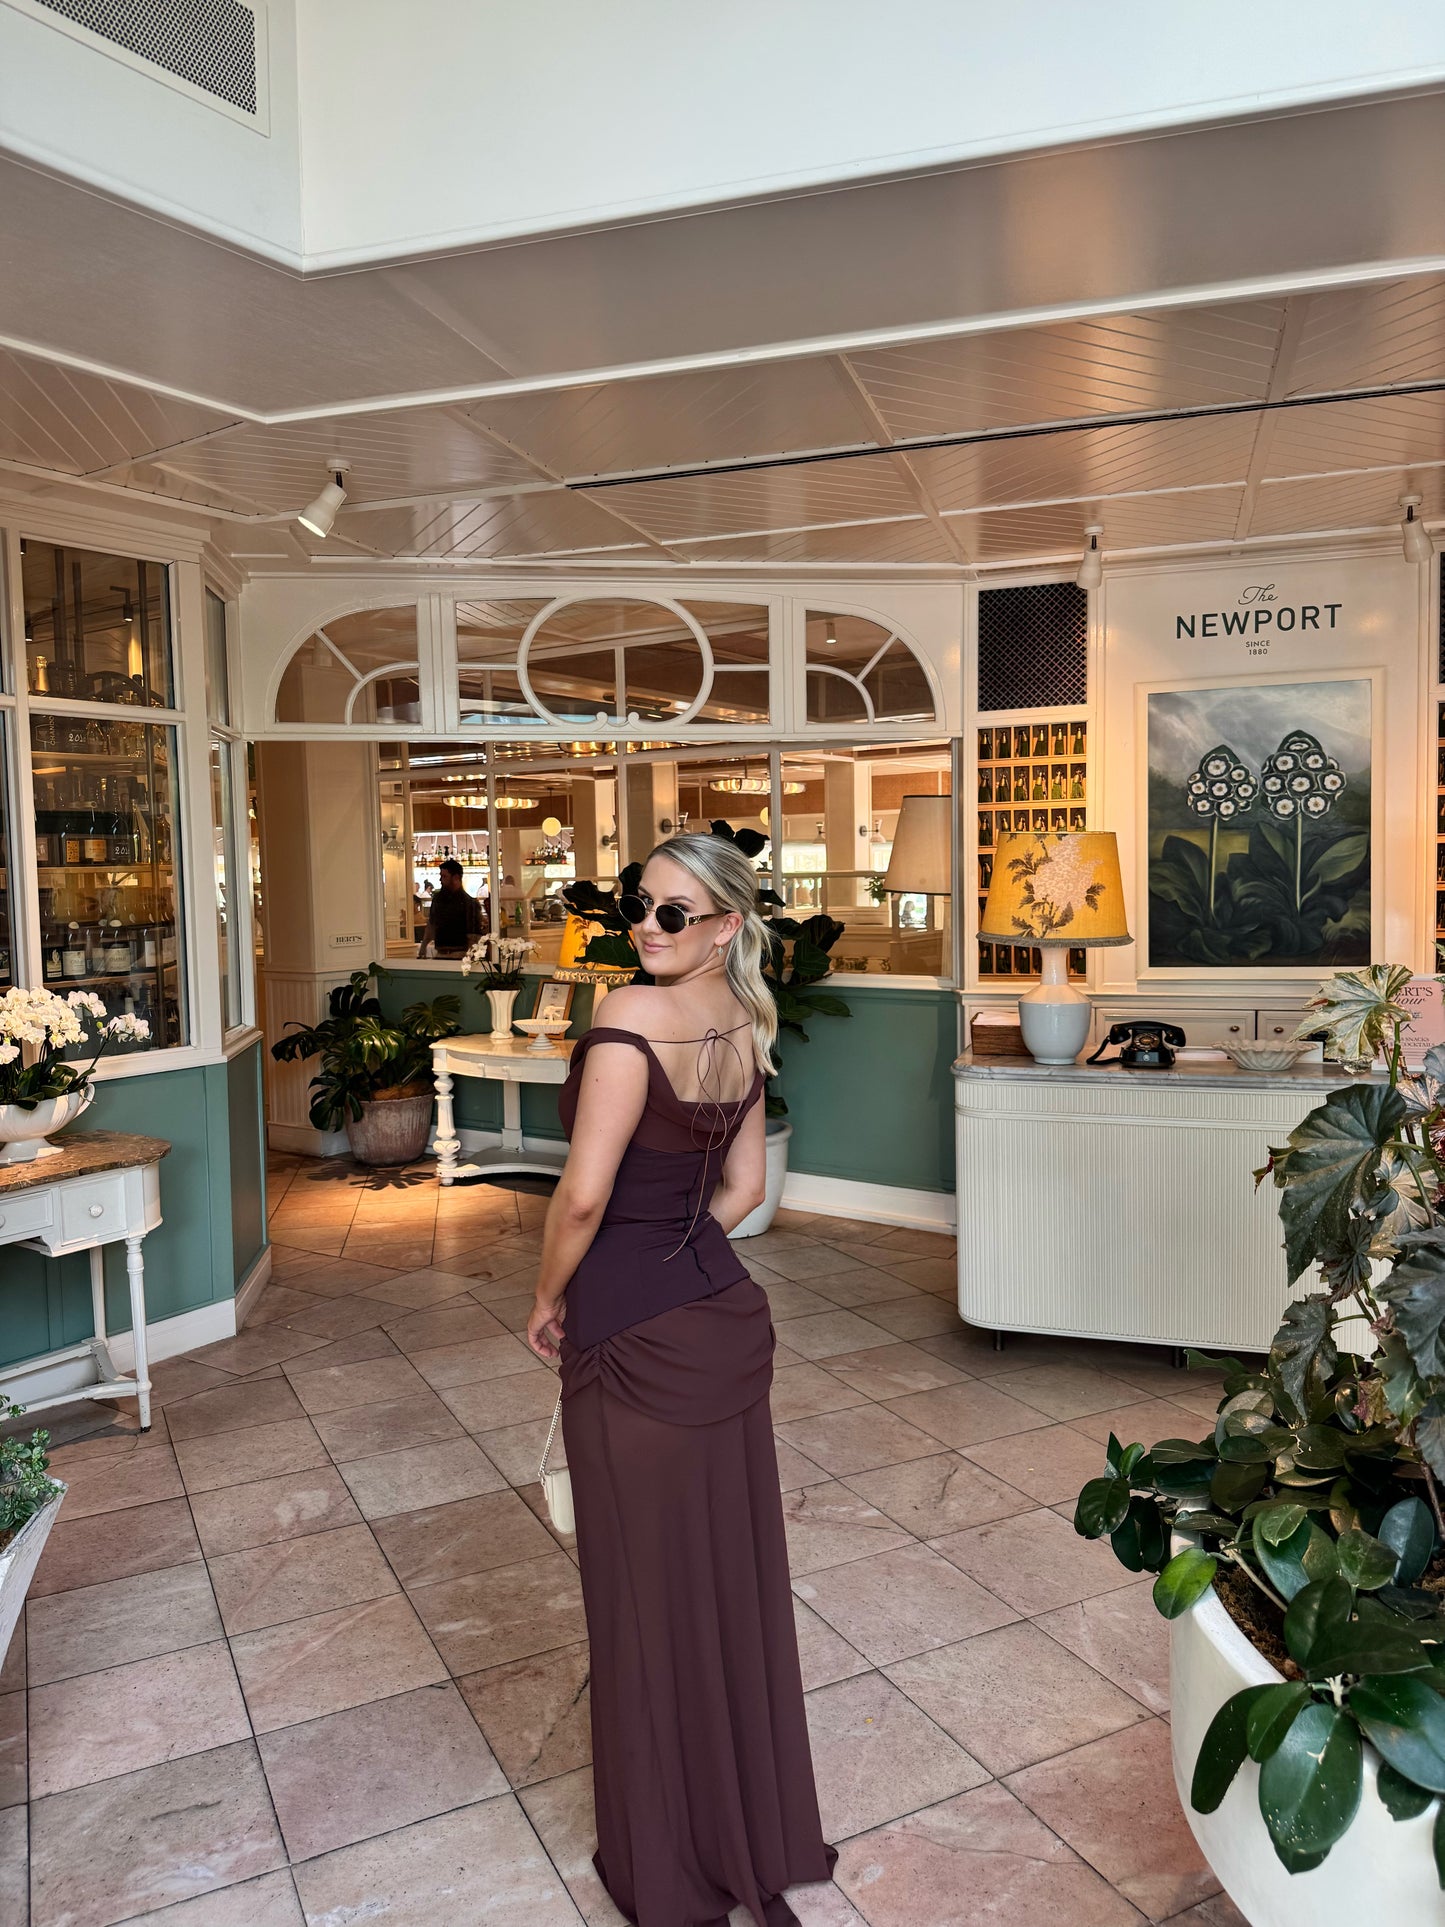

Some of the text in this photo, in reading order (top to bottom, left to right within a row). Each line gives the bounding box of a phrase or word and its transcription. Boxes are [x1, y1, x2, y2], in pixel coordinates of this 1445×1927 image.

[1238, 583, 1279, 605] The
[1176, 603, 1342, 639] NEWPORT
[1245, 640, 1270, 648] SINCE
[1392, 993, 1425, 1005] hour
